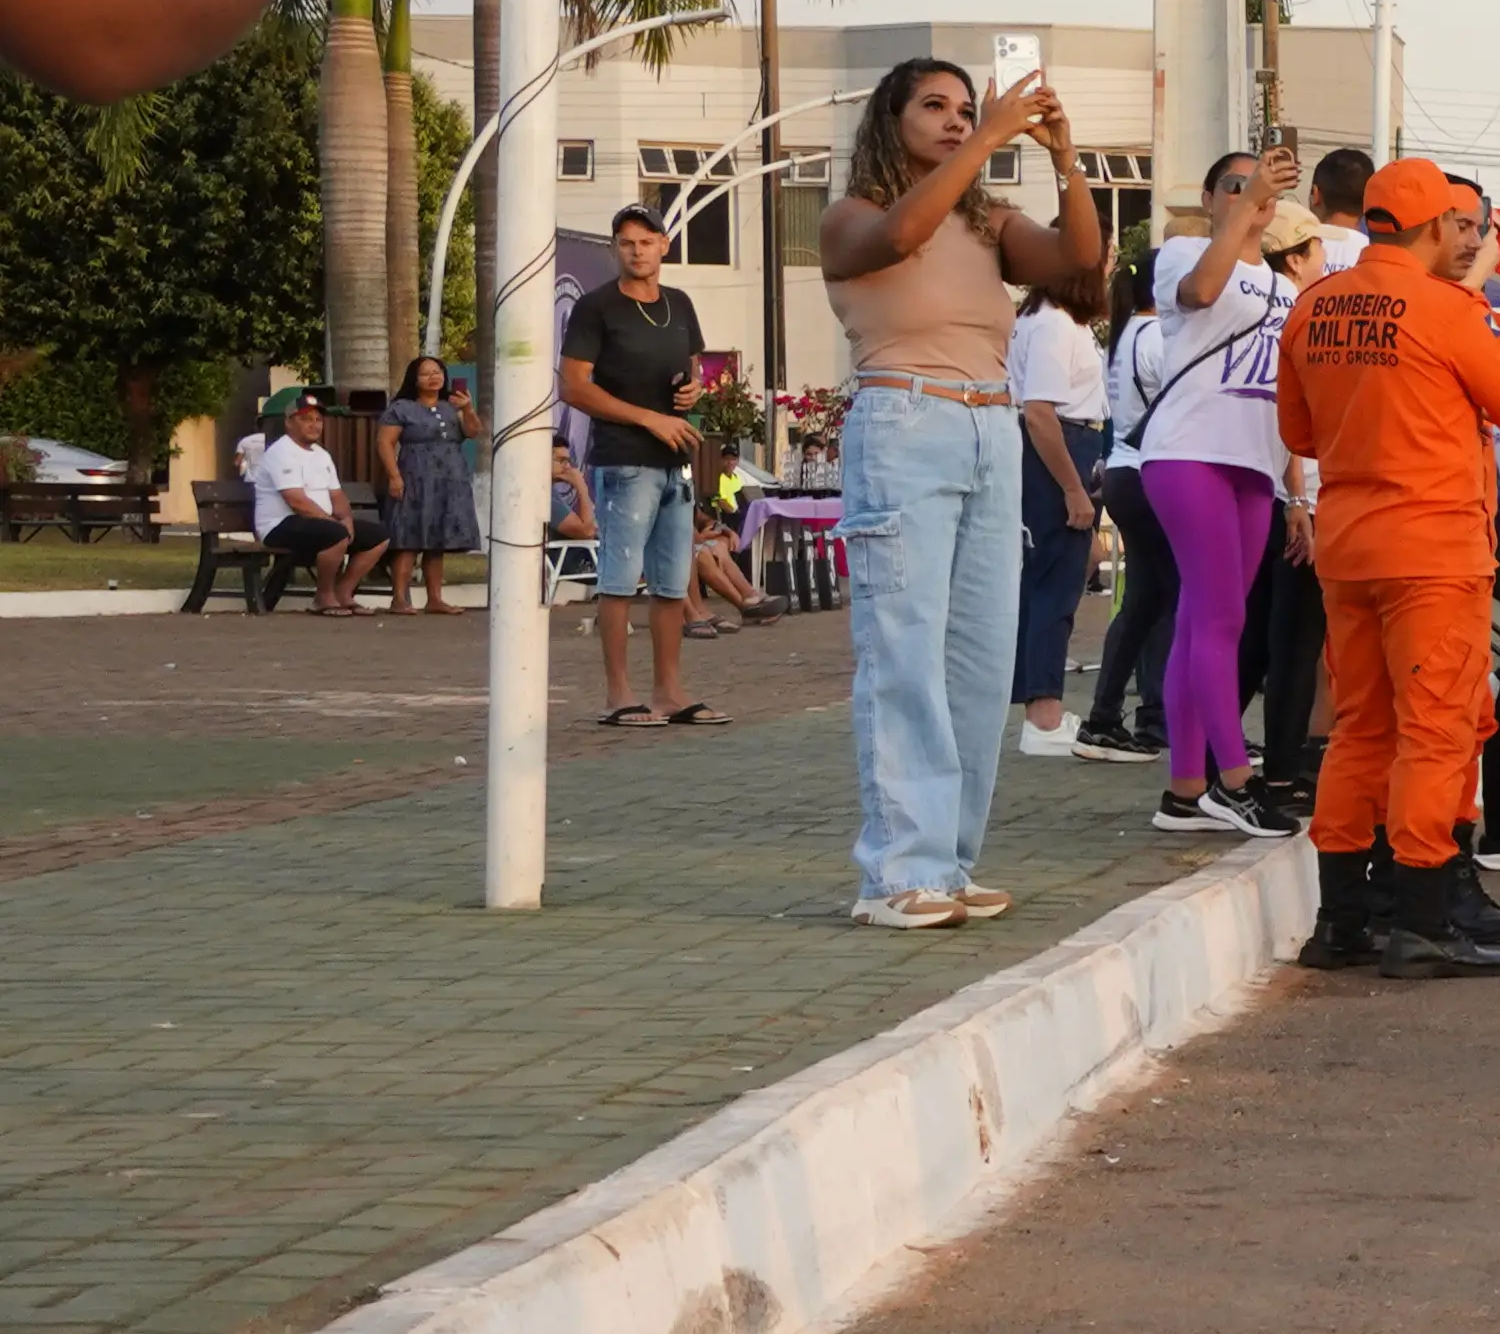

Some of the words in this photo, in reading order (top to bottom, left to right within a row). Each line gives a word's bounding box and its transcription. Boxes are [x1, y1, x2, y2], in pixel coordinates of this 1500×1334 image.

[1312, 294, 1407, 319] BOMBEIRO
[1306, 320, 1398, 349] MILITAR
[1221, 331, 1278, 385] VID
[1306, 351, 1339, 365] MATO
[1345, 351, 1399, 367] GROSSO
